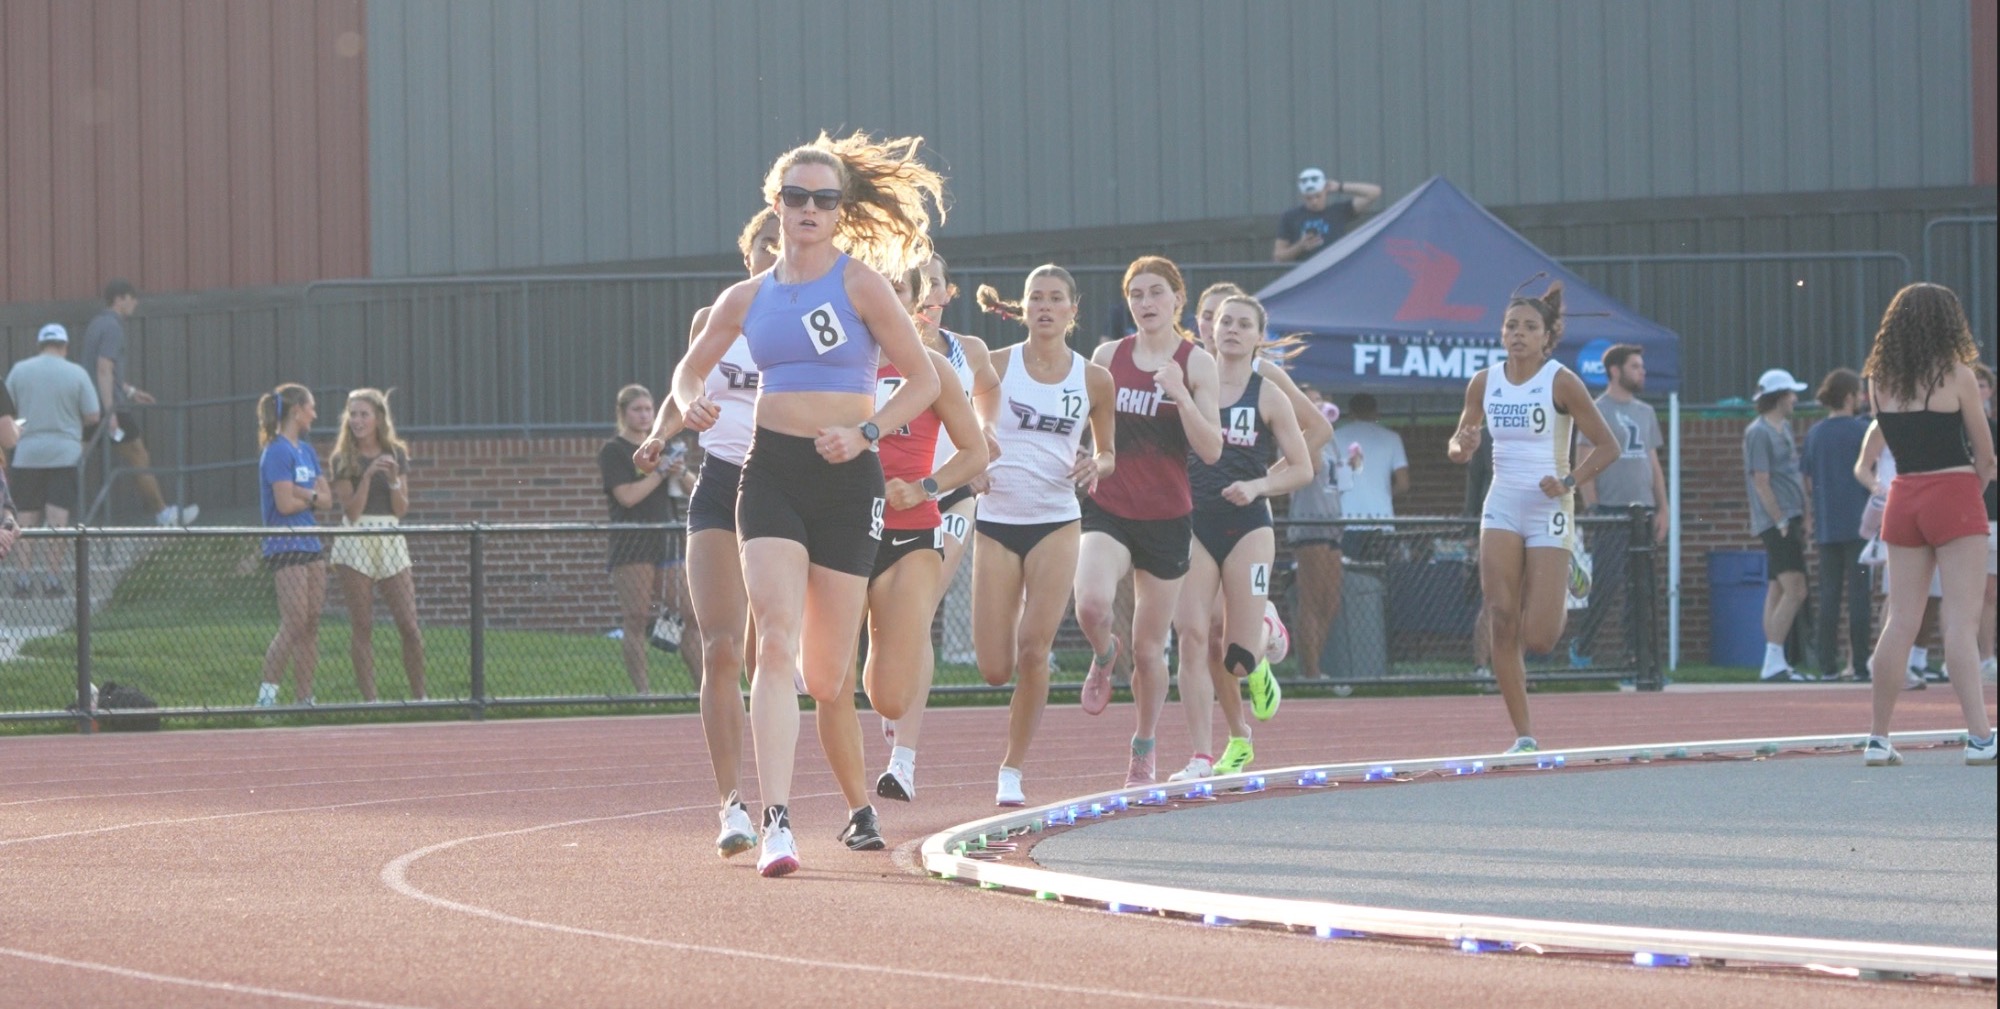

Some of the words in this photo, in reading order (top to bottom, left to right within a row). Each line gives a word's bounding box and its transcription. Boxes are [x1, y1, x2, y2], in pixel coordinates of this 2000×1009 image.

[810, 309, 838, 347] 8
[1400, 335, 1503, 347] UNIVERSIT
[728, 371, 760, 390] LE
[1062, 395, 1082, 419] 12
[1018, 412, 1076, 436] LEE
[1234, 409, 1250, 436] 4
[1533, 408, 1546, 434] 9
[944, 514, 965, 539] 10
[1553, 512, 1565, 535] 9
[1255, 565, 1266, 592] 4
